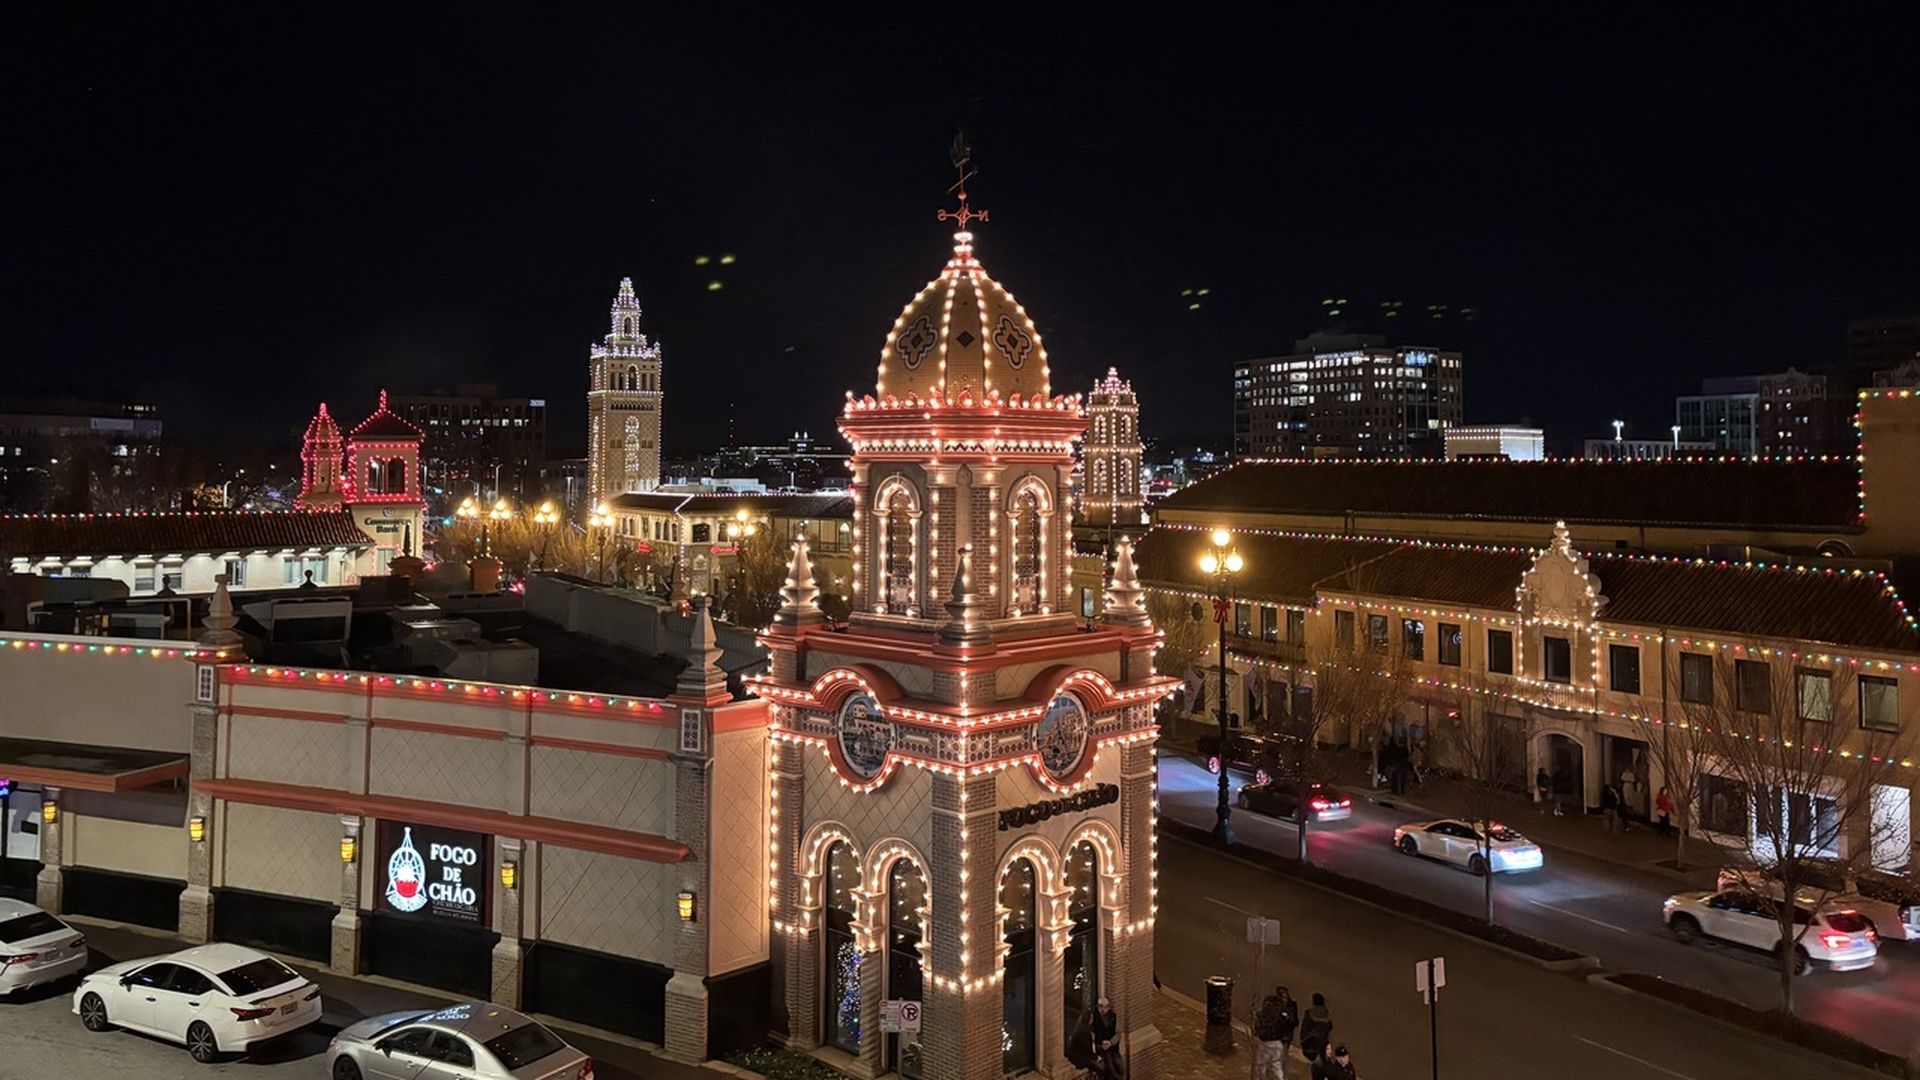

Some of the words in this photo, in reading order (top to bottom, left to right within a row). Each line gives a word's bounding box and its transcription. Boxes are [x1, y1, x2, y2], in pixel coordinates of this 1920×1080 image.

[376, 525, 399, 533] Bank
[430, 843, 477, 866] FOGO
[442, 866, 462, 882] DE
[428, 883, 476, 905] CHÃO
